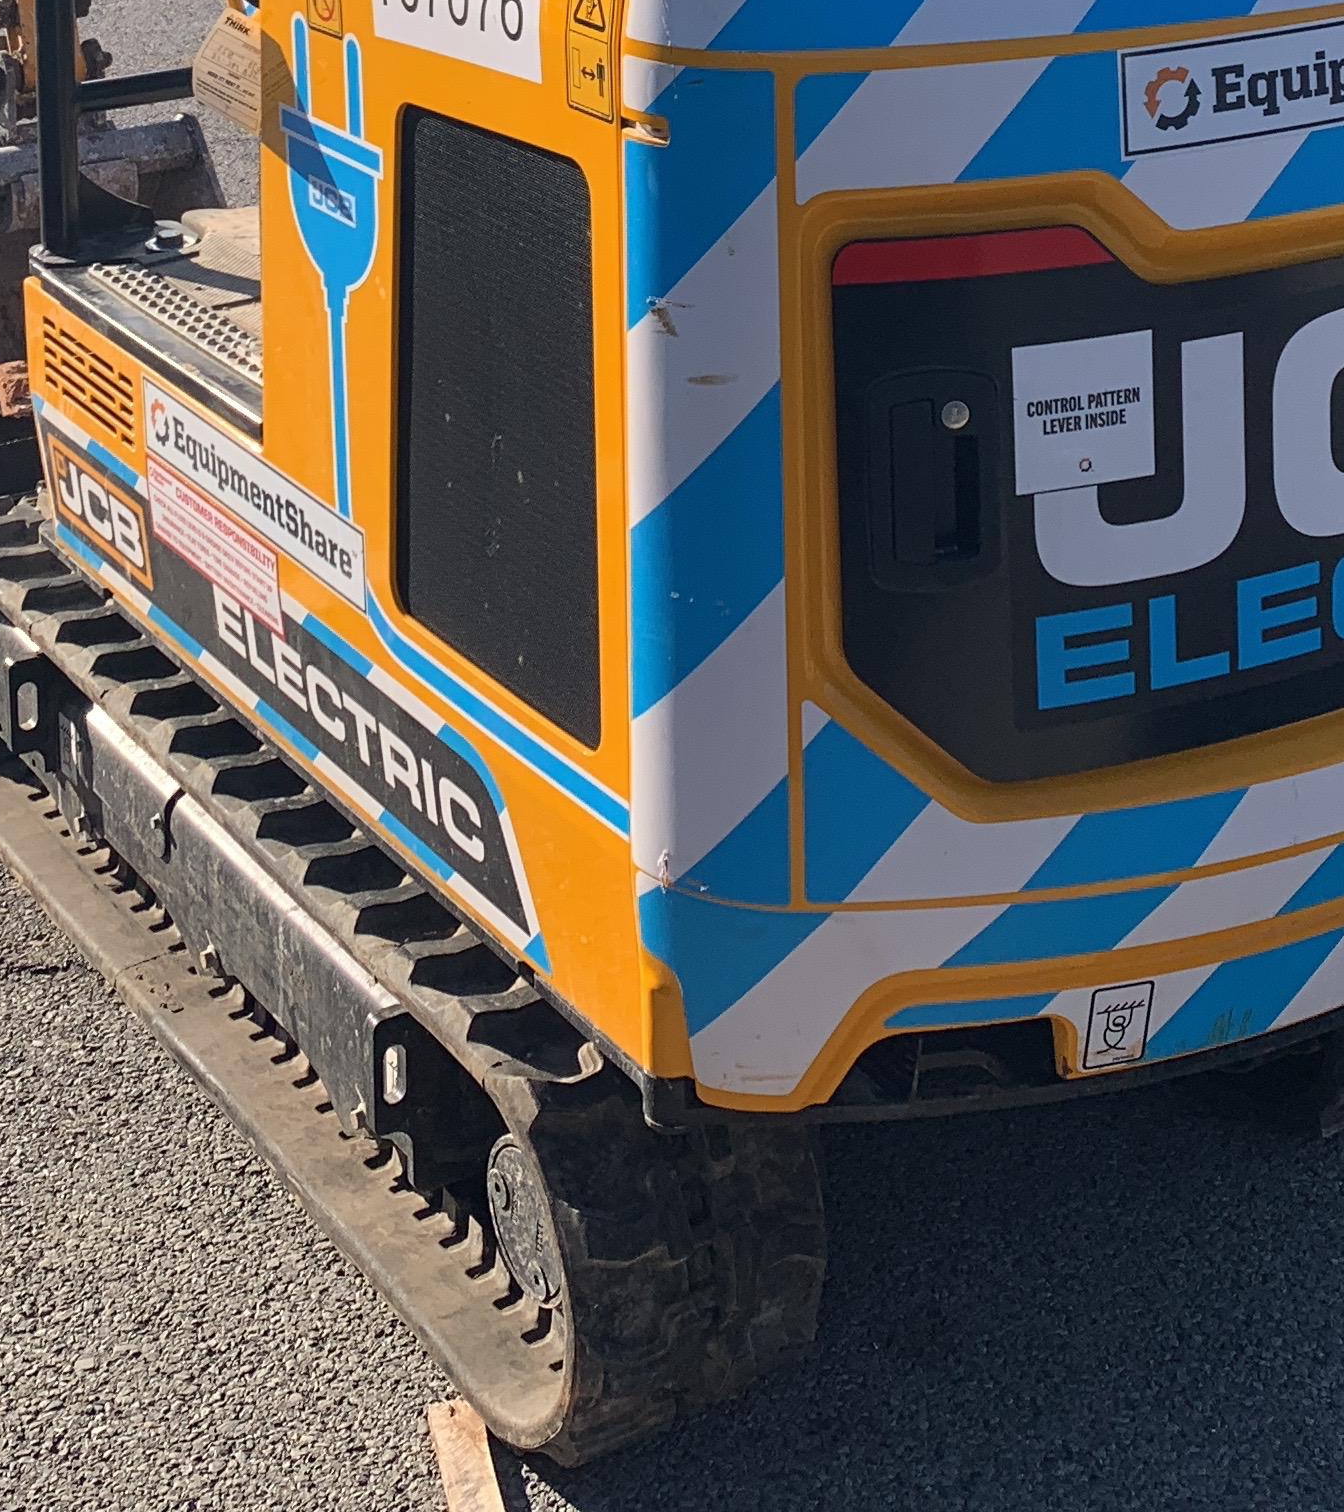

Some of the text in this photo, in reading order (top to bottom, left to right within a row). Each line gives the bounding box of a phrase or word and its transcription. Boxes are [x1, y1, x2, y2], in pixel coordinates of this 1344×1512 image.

[1027, 387, 1141, 418] CONTROL PATTERN
[1043, 408, 1127, 436] LEVER INSIDE
[59, 462, 144, 568] JCB
[172, 416, 354, 580] EquipmentShare
[213, 581, 485, 863] ELECTRIC
